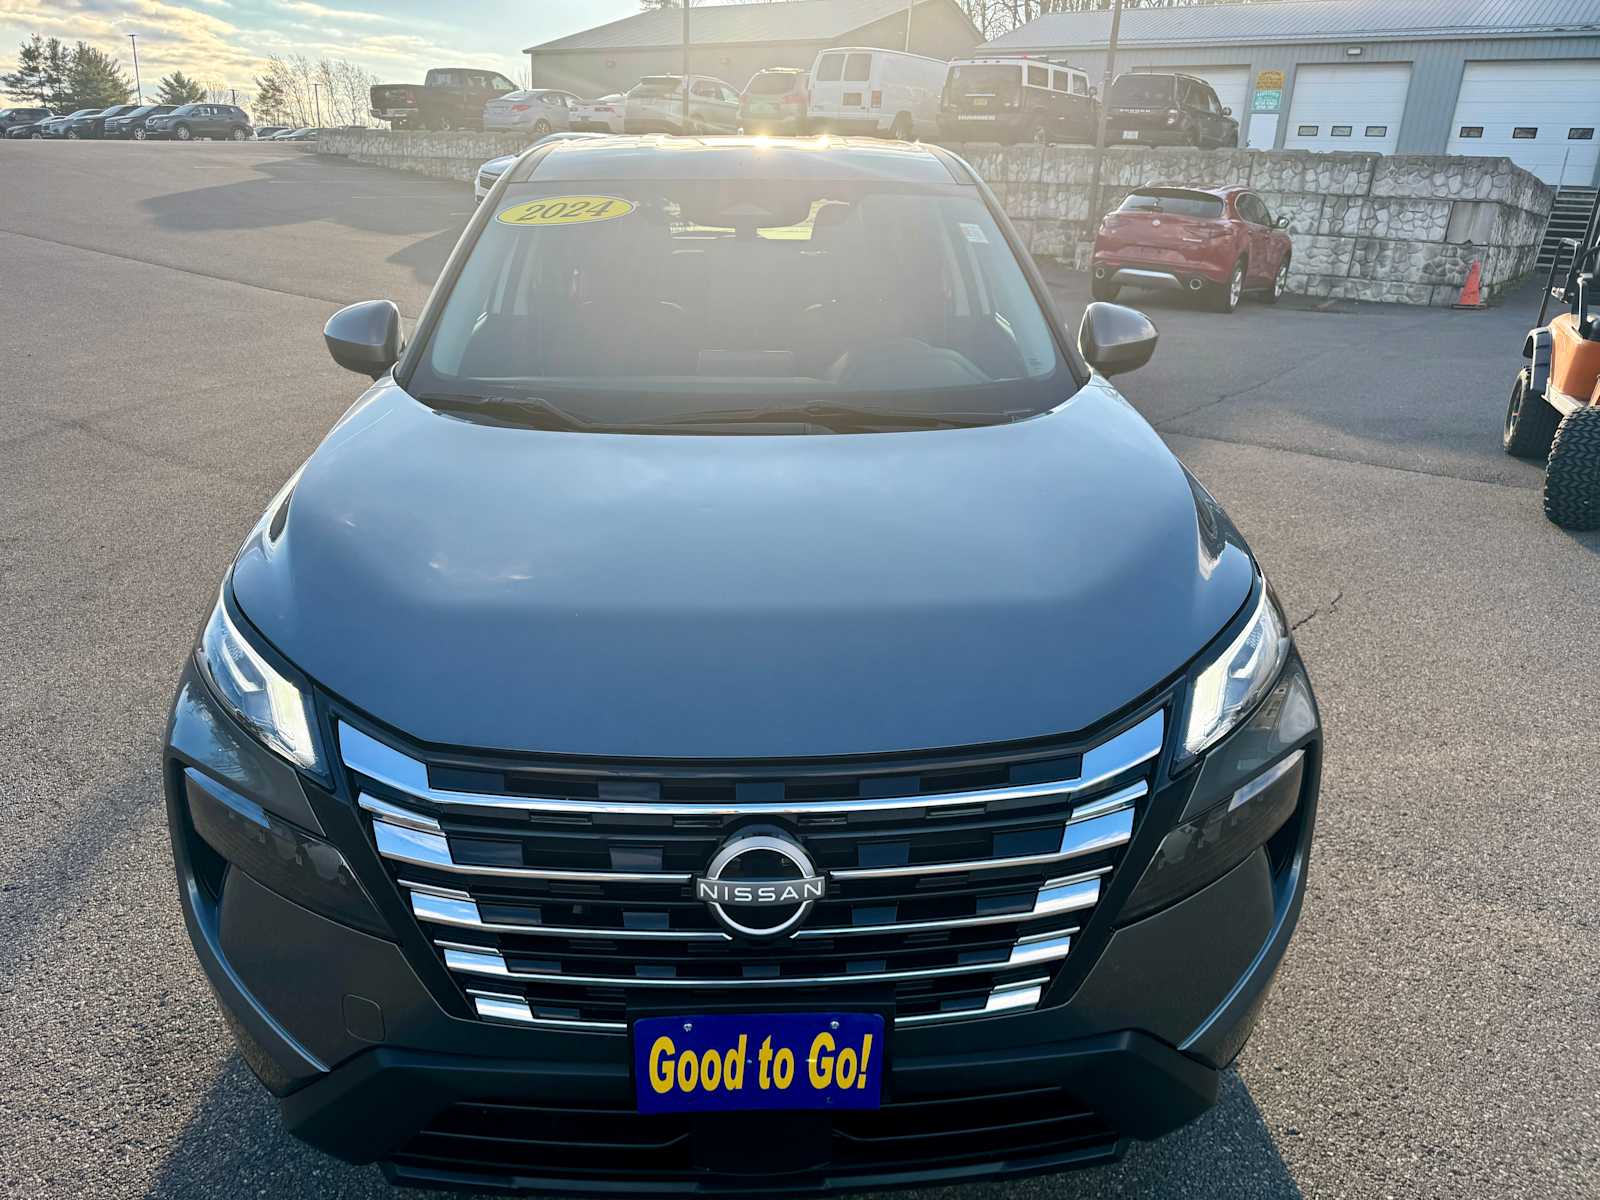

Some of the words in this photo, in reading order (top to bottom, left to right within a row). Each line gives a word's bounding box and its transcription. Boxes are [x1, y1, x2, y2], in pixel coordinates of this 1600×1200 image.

[516, 200, 613, 222] 2024
[699, 881, 822, 902] NISSAN
[649, 1034, 747, 1094] Good
[758, 1035, 795, 1090] to
[808, 1032, 873, 1089] Go!
